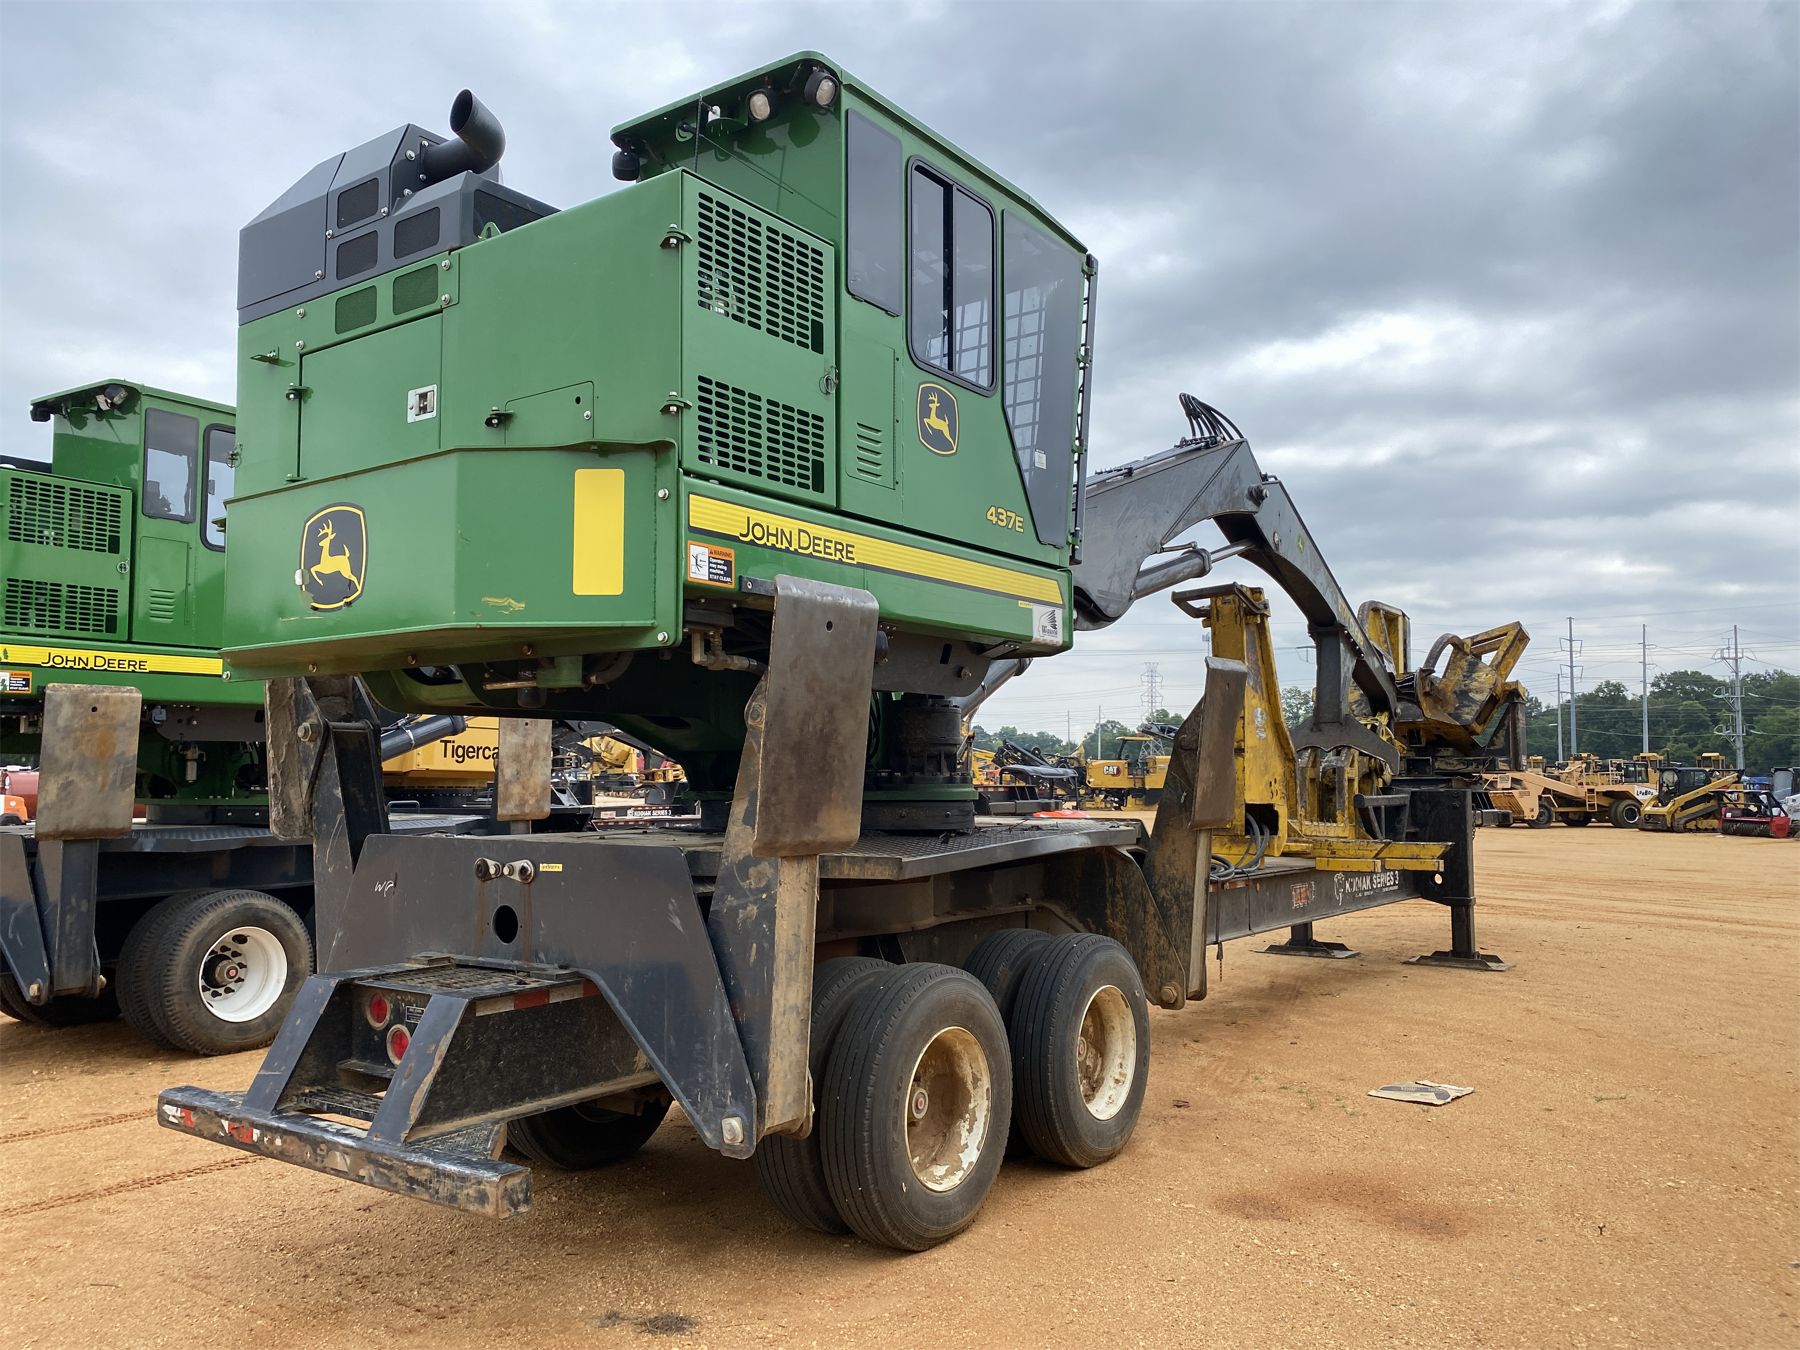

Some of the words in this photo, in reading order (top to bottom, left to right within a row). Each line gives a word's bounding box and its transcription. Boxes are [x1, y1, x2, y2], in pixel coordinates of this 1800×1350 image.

[986, 505, 1024, 533] 437E
[739, 516, 793, 548] JOHN
[797, 528, 856, 561] DEERE
[41, 652, 89, 667] JOHN
[94, 655, 148, 670] DEERE
[1103, 765, 1118, 775] CAT
[1395, 870, 1399, 884] 3
